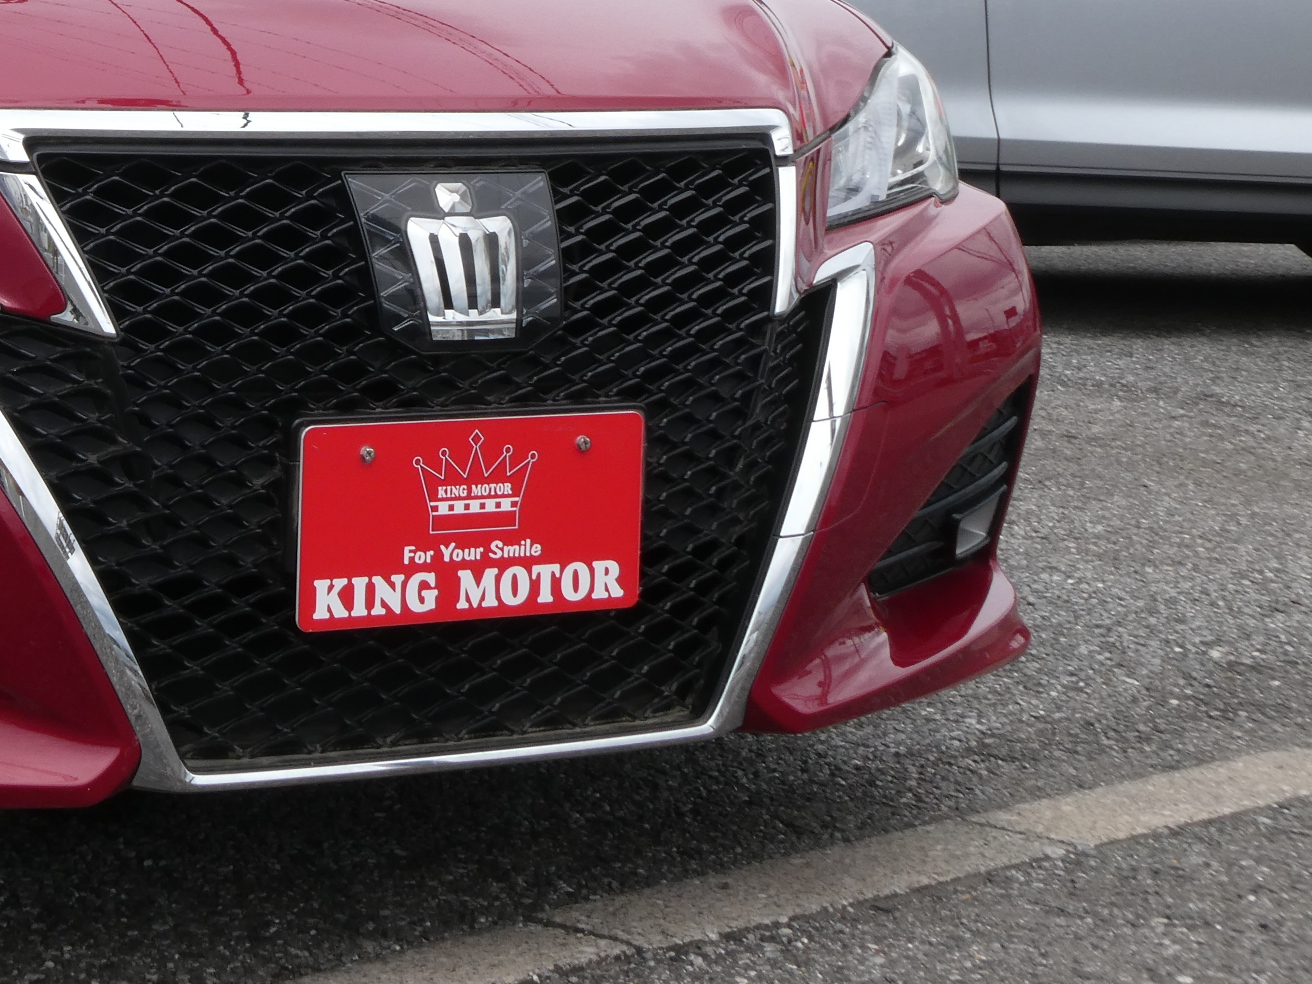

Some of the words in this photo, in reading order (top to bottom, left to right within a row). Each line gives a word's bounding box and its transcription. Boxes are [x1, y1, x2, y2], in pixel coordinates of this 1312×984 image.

[437, 485, 468, 499] KING
[470, 482, 513, 497] MOTOR
[403, 546, 434, 565] For
[440, 542, 484, 562] Your
[488, 539, 542, 559] Smile
[312, 571, 439, 620] KING
[456, 559, 624, 610] MOTOR
